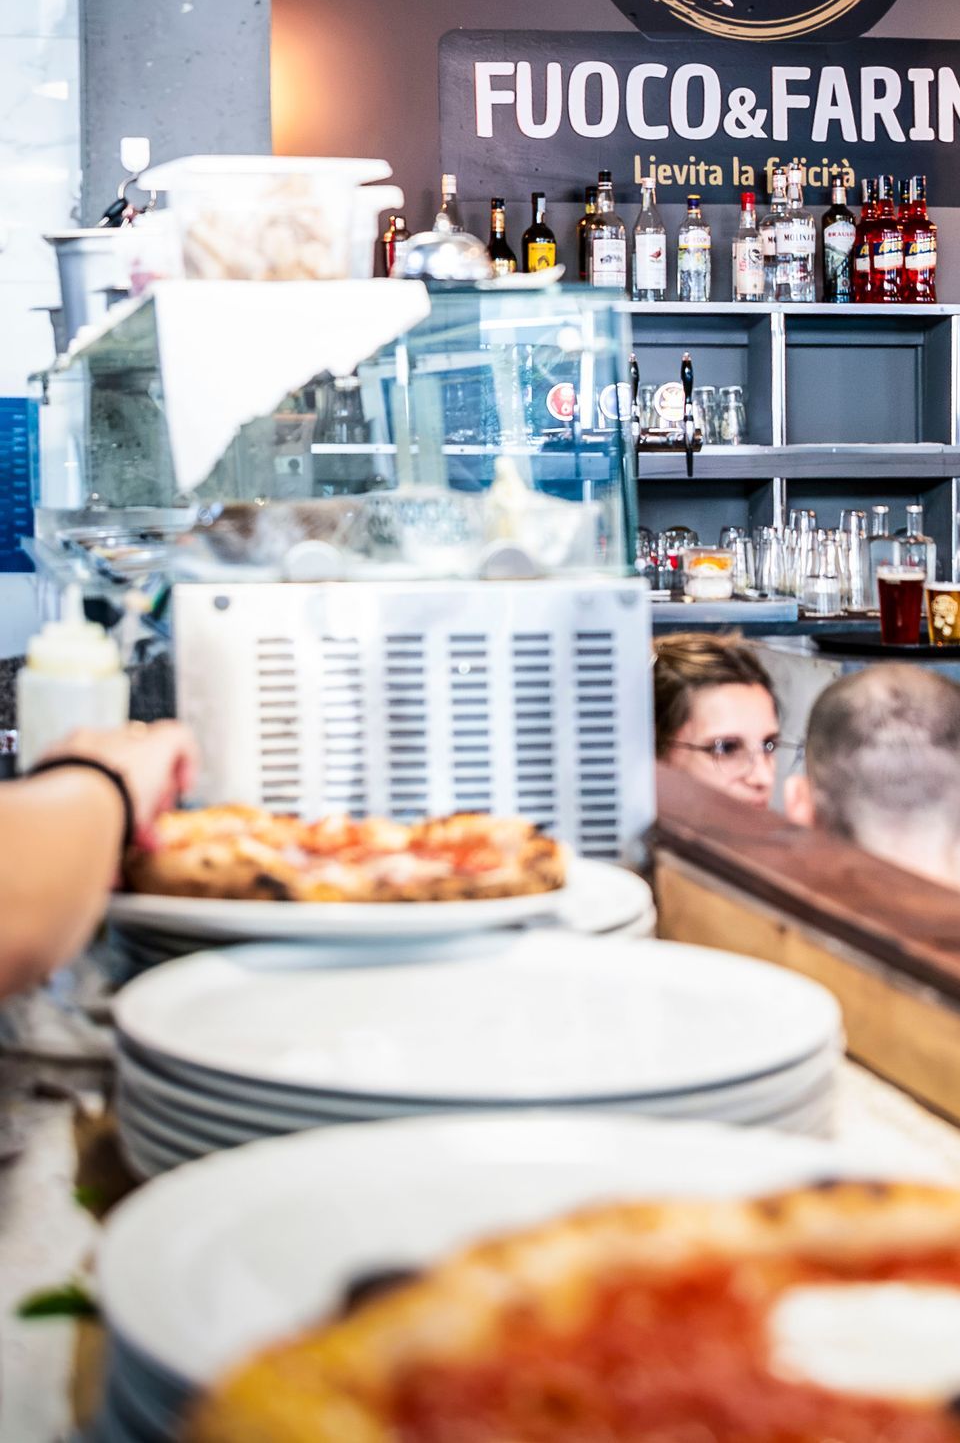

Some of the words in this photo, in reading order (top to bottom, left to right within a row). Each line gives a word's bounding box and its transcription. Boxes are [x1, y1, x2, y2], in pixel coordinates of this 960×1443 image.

[634, 155, 723, 186] Lievita
[733, 156, 755, 186] la
[763, 157, 856, 194] ficità
